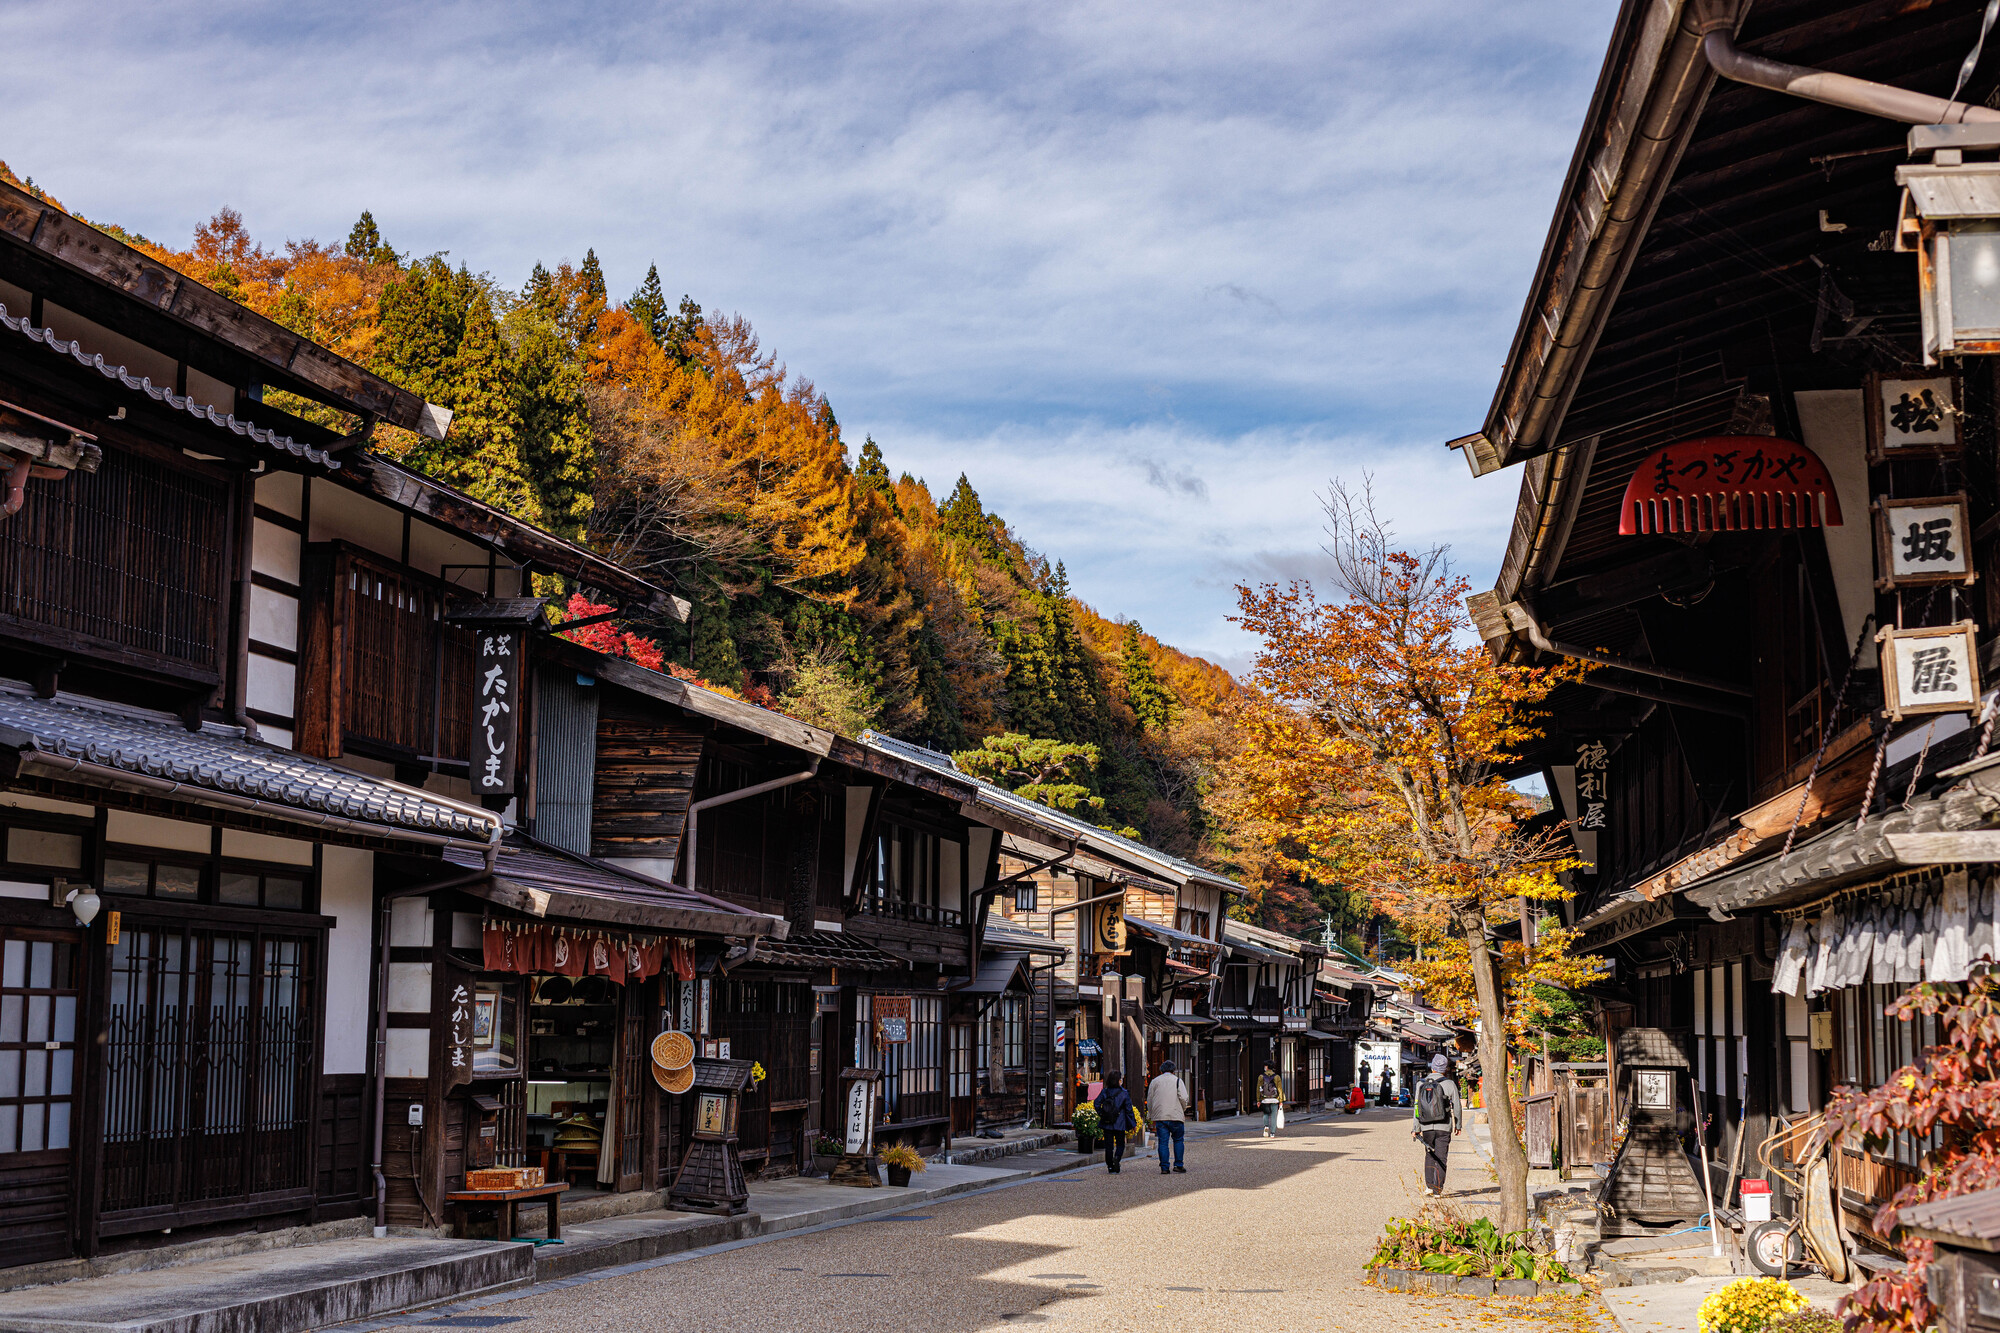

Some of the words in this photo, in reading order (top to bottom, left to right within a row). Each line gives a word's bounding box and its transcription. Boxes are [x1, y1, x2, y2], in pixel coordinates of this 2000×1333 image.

[483, 634, 511, 657] 民芸
[482, 664, 510, 787] たかしま
[1575, 739, 1610, 829] 徳利屋
[451, 984, 469, 1067] たかしま
[682, 983, 692, 1030] たかしま
[705, 1099, 714, 1129] たかしま
[852, 1085, 863, 1133] 手打そば
